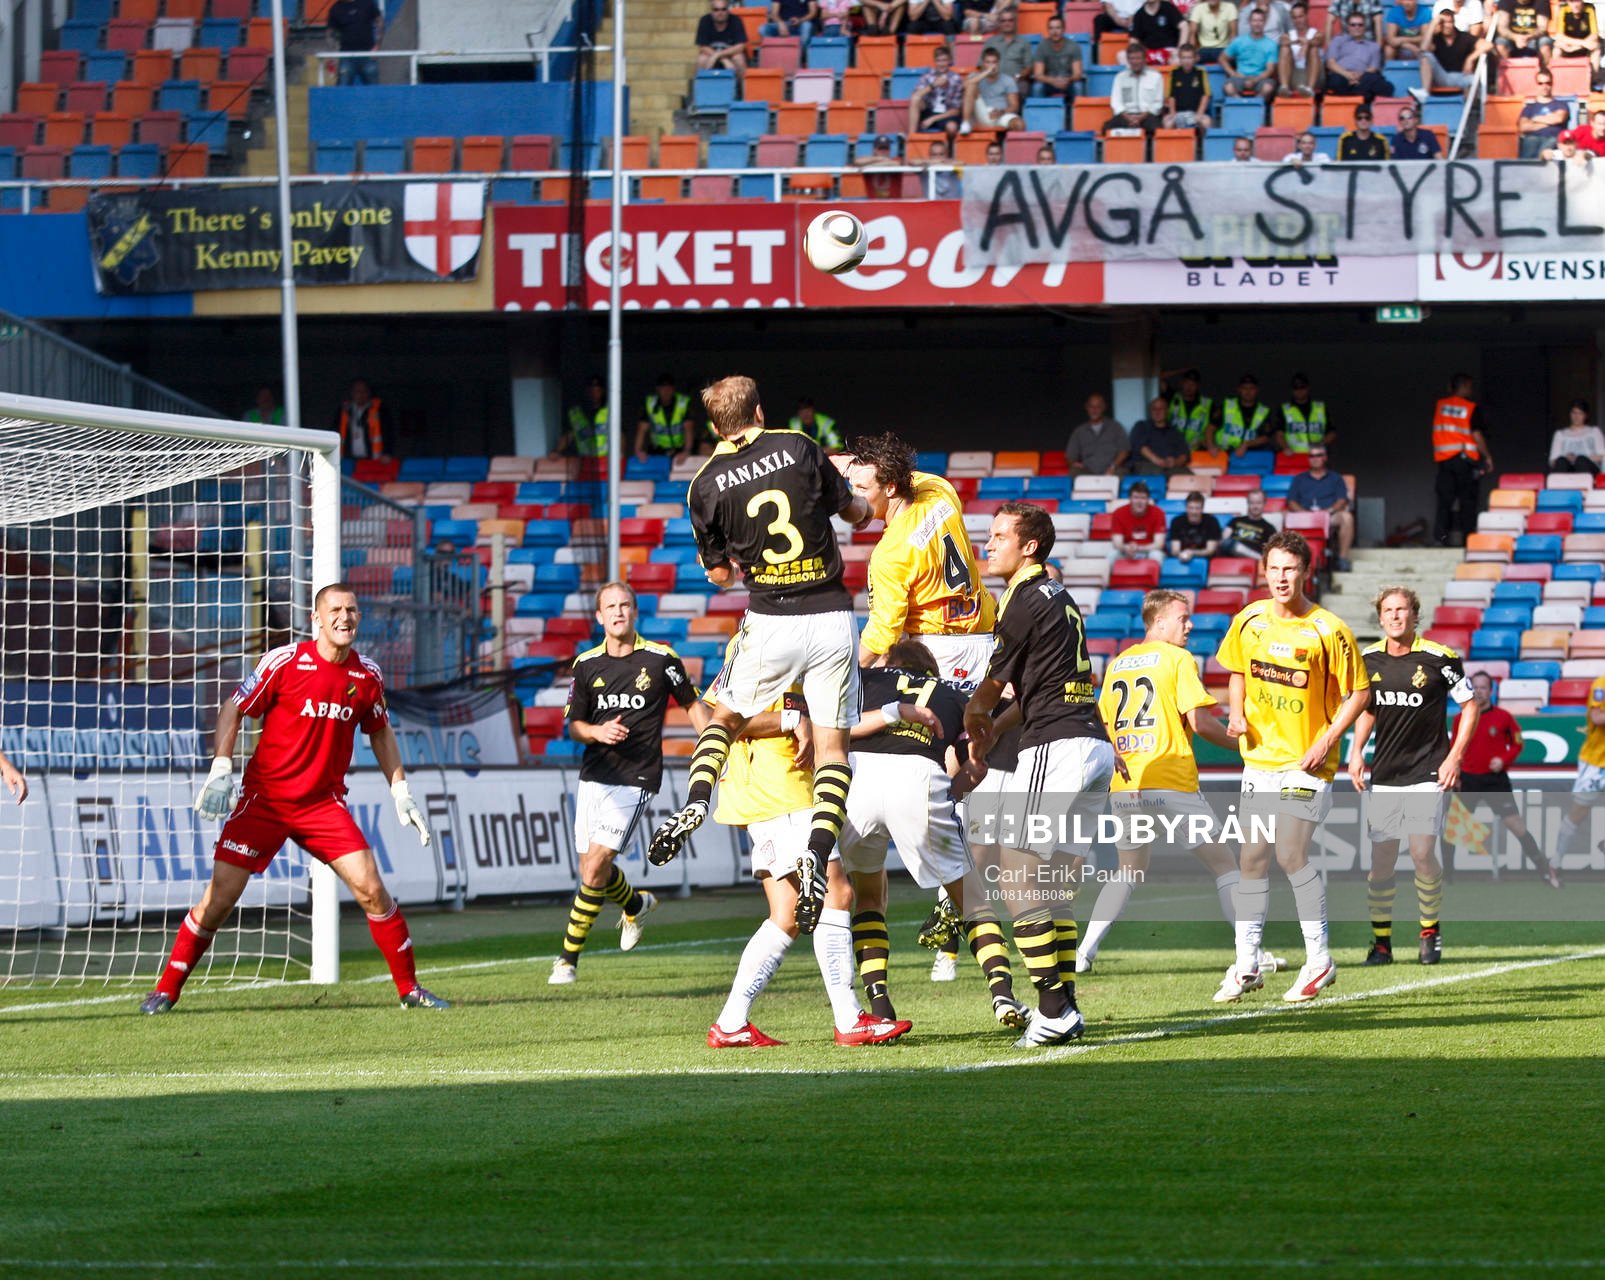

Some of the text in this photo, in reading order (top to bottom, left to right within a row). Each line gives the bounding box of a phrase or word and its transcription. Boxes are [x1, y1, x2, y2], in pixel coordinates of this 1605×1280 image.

[343, 206, 392, 226] one
[979, 165, 1205, 252] AVGÅ
[196, 240, 364, 272] Kenny Pavey
[507, 229, 787, 288] TICKET
[1186, 271, 1339, 287] BLADET
[714, 449, 796, 493] PANAXIA
[746, 489, 805, 565] 3
[941, 532, 973, 597] 4
[1064, 604, 1092, 673] 2
[300, 698, 354, 721] ÅBRO
[1112, 675, 1157, 732] 22
[1116, 733, 1155, 751] BDO
